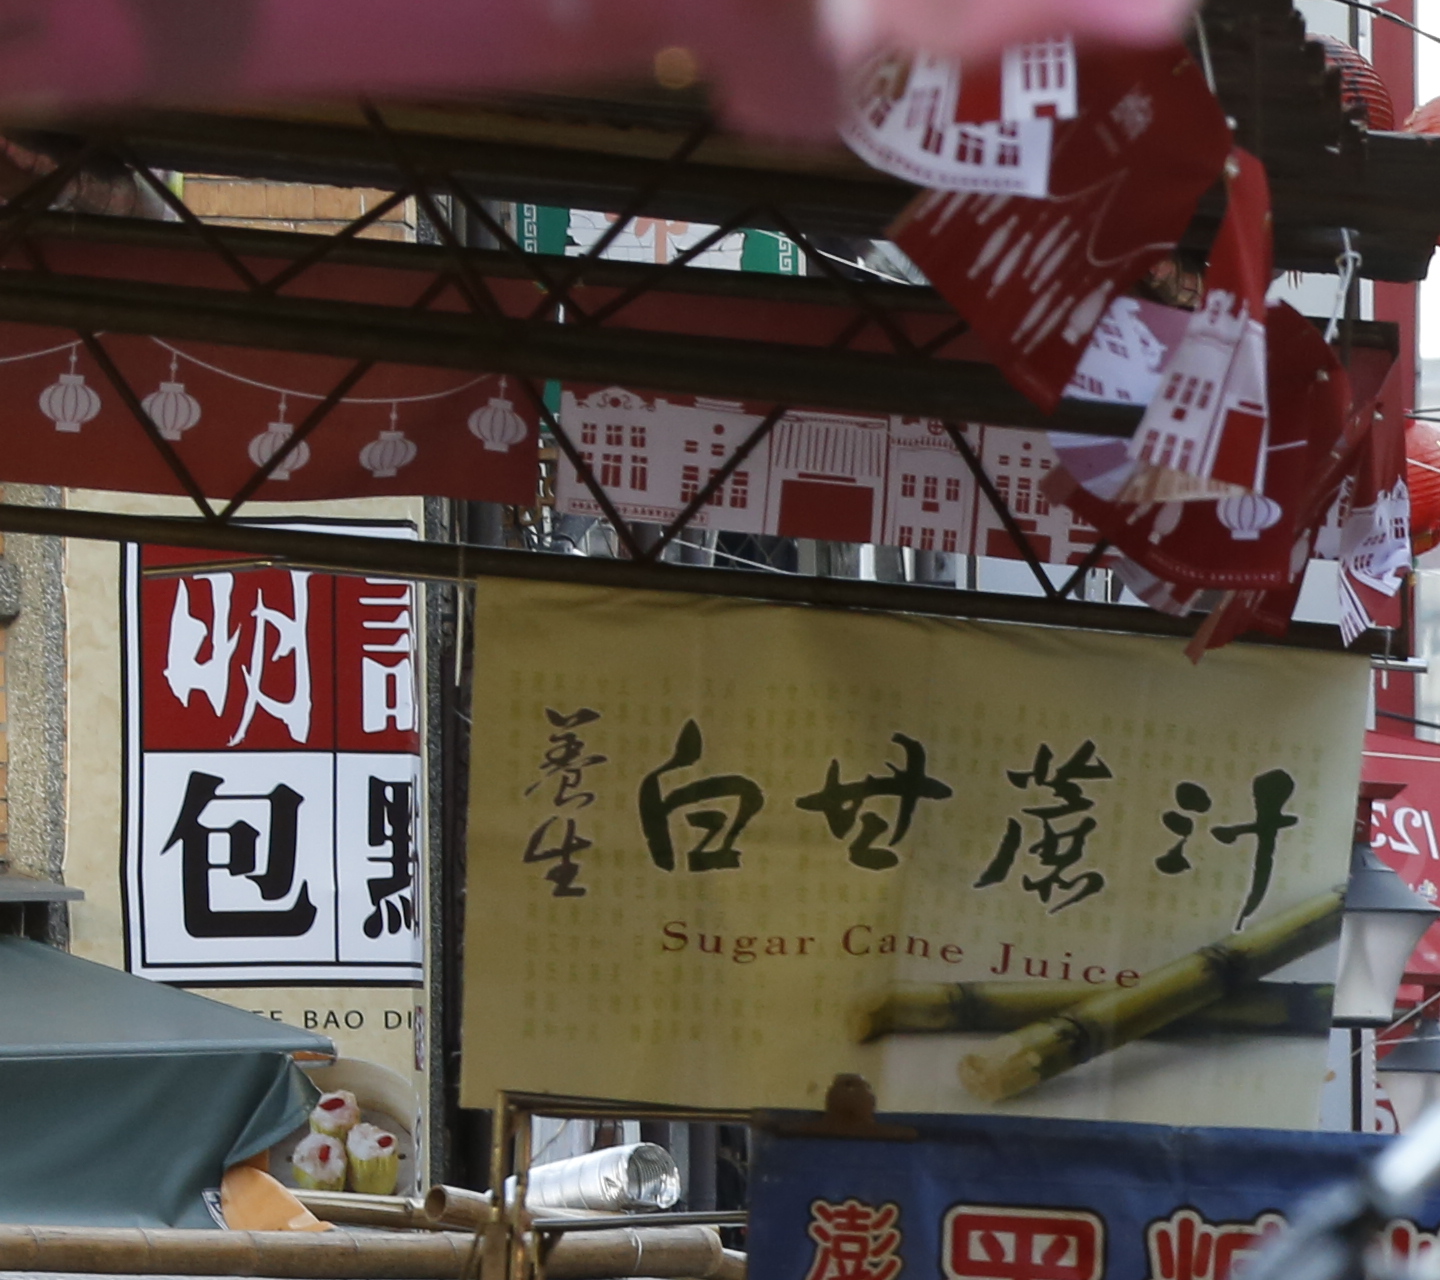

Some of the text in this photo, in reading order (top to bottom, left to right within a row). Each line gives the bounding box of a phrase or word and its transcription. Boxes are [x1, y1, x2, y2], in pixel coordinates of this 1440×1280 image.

[521, 706, 610, 898] 養生
[636, 717, 1300, 933] 白甘蔗汁
[303, 1009, 365, 1030] BAO
[384, 1009, 414, 1030] DI
[660, 918, 1145, 992] Sugar Cane Juice
